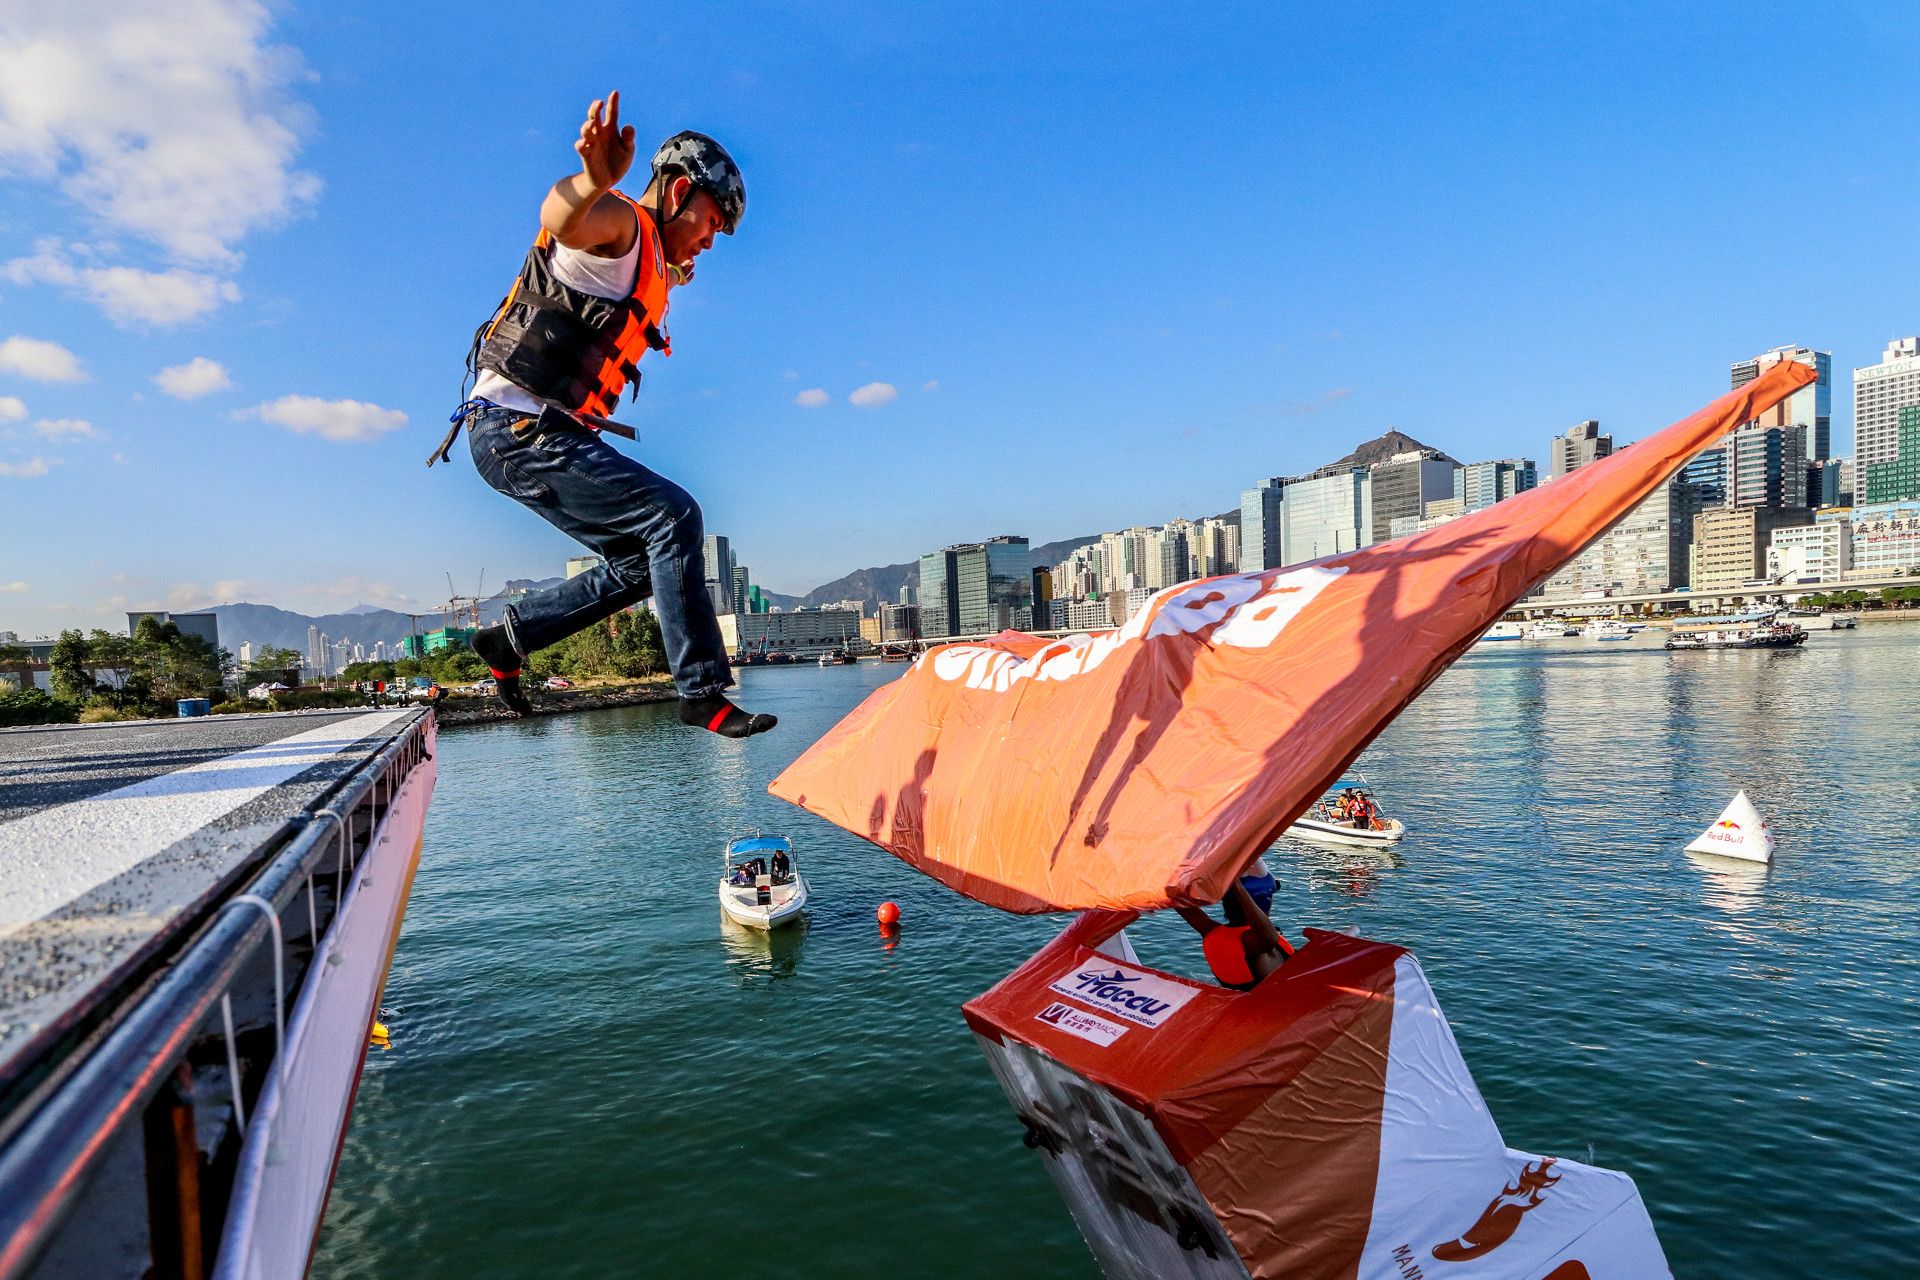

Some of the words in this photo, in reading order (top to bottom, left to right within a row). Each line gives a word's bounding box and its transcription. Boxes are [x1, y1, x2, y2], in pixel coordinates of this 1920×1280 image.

[1858, 361, 1912, 379] NEWTON
[1707, 831, 1724, 841] Red
[1724, 833, 1744, 844] Bull
[1076, 974, 1171, 1016] Macau
